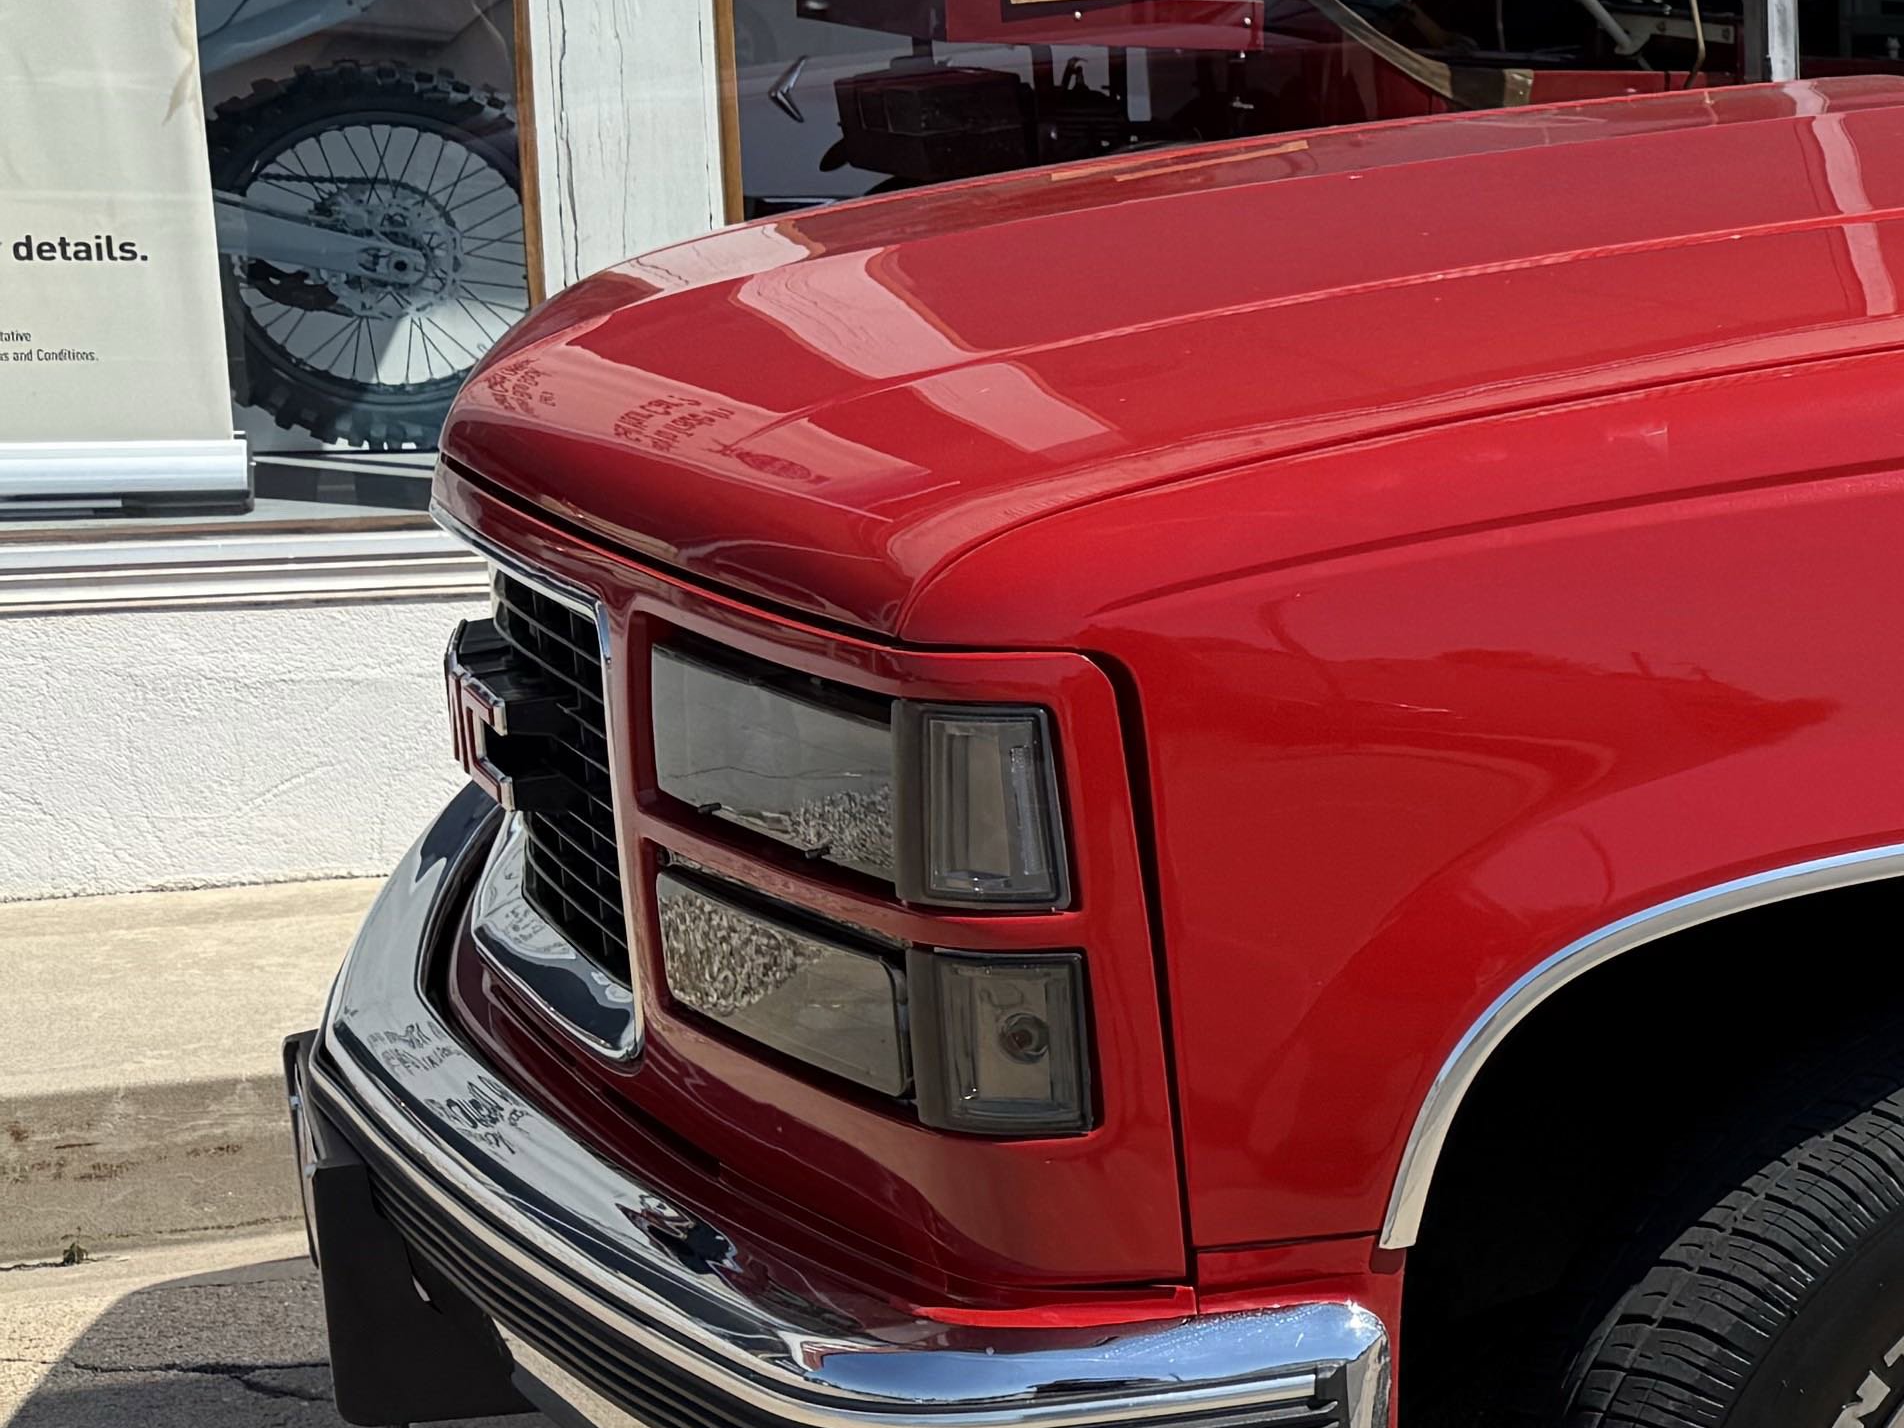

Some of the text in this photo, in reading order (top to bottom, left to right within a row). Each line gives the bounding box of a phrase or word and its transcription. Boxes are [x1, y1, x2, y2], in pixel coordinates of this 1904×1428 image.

[13, 235, 148, 262] details.
[13, 349, 32, 362] and
[37, 348, 99, 362] Conditions.
